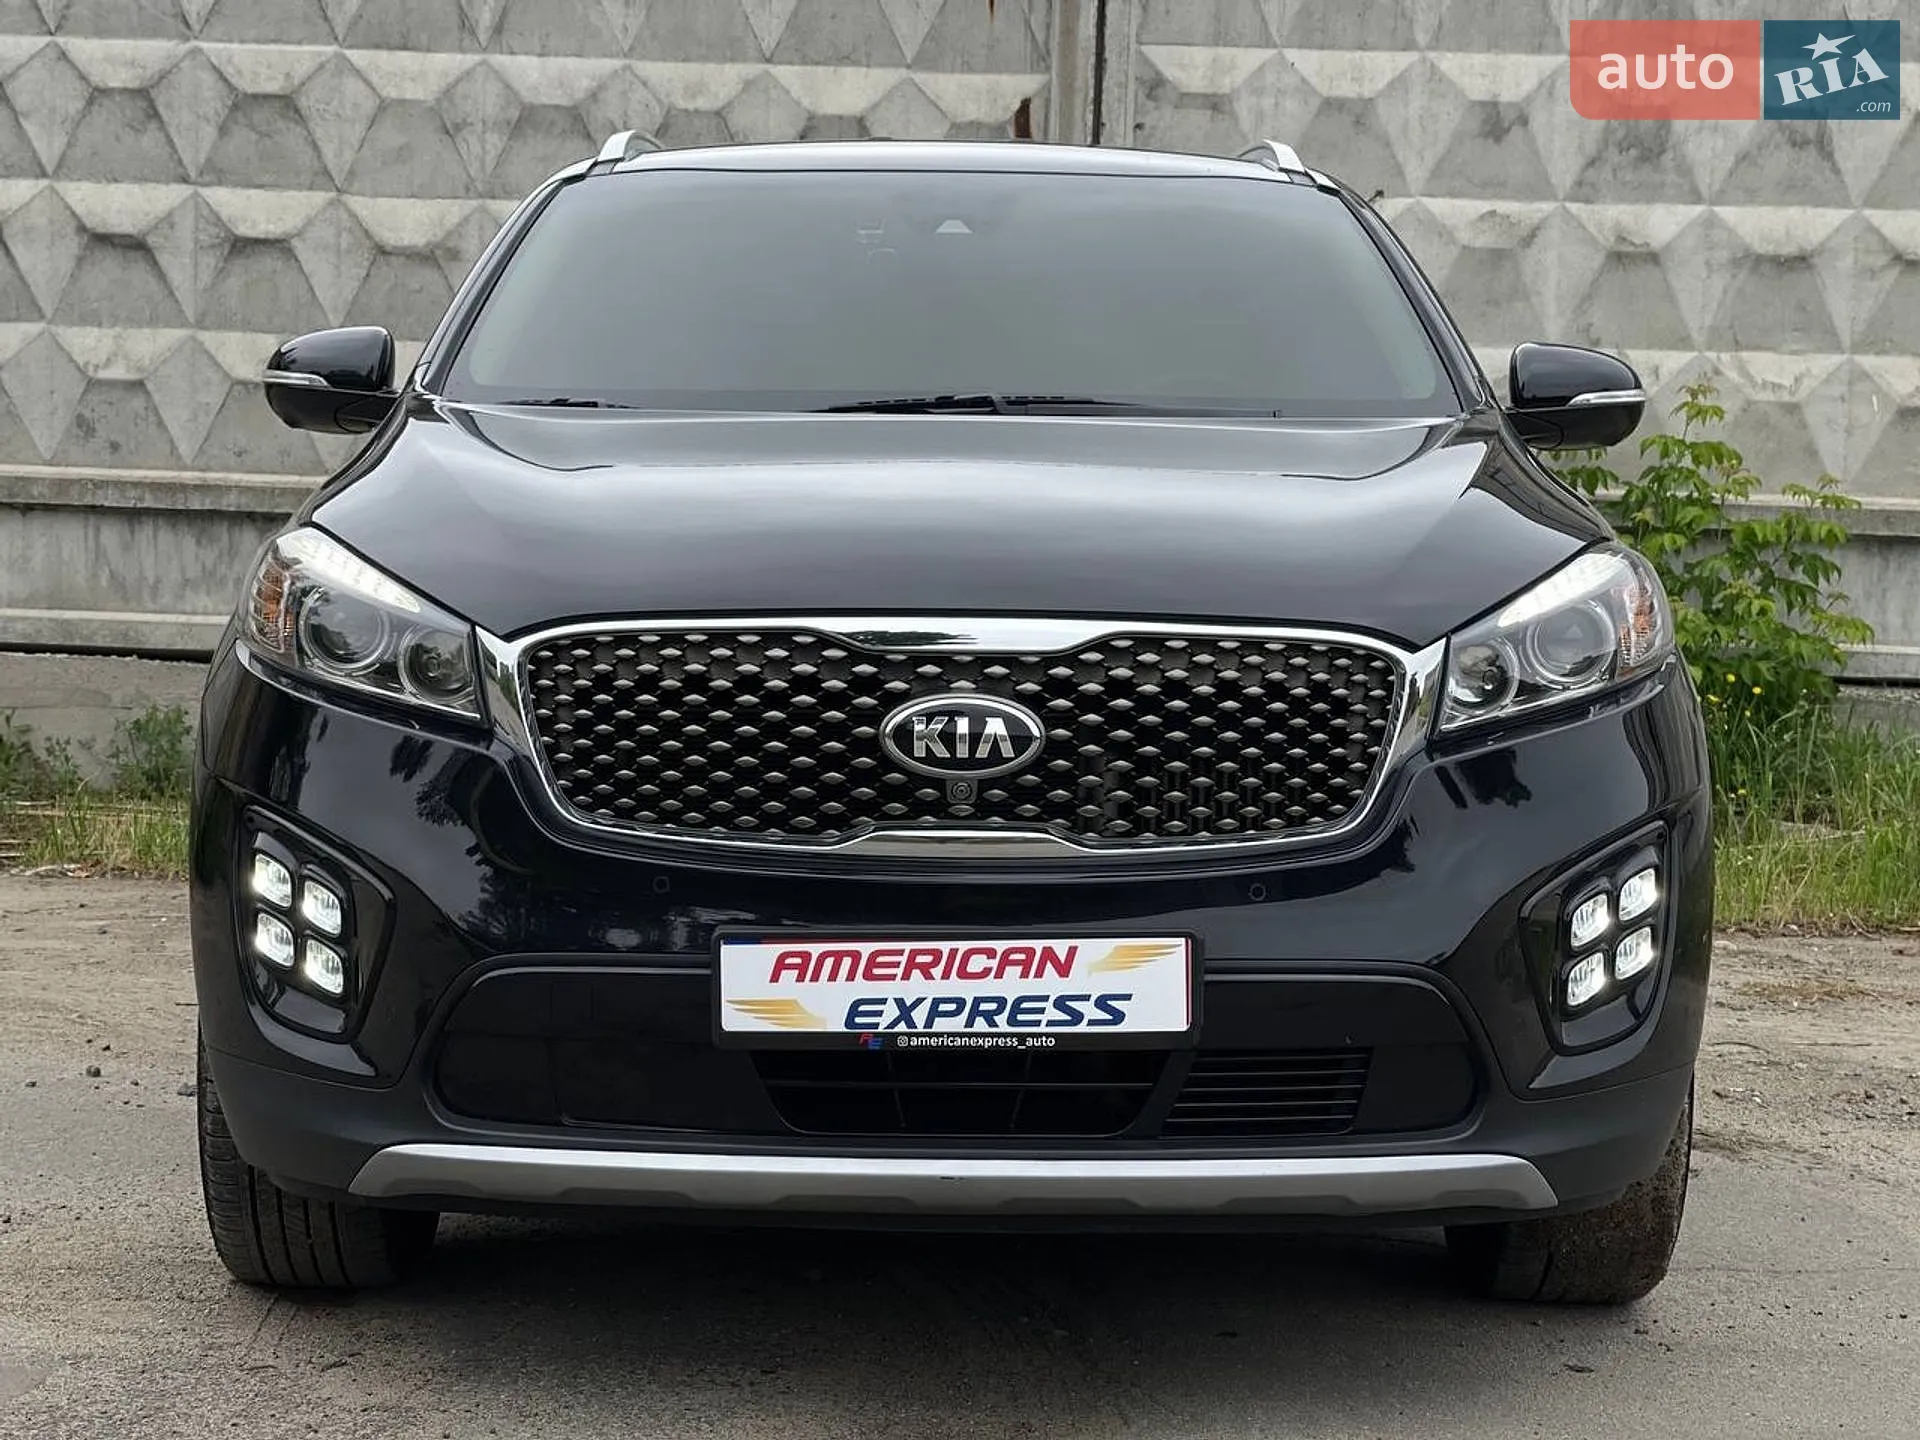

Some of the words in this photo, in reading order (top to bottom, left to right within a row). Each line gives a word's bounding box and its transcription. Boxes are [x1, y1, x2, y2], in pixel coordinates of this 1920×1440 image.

[912, 716, 1015, 758] KIA
[769, 945, 1078, 983] AMERICAN
[844, 993, 1133, 1030] EXPRESS
